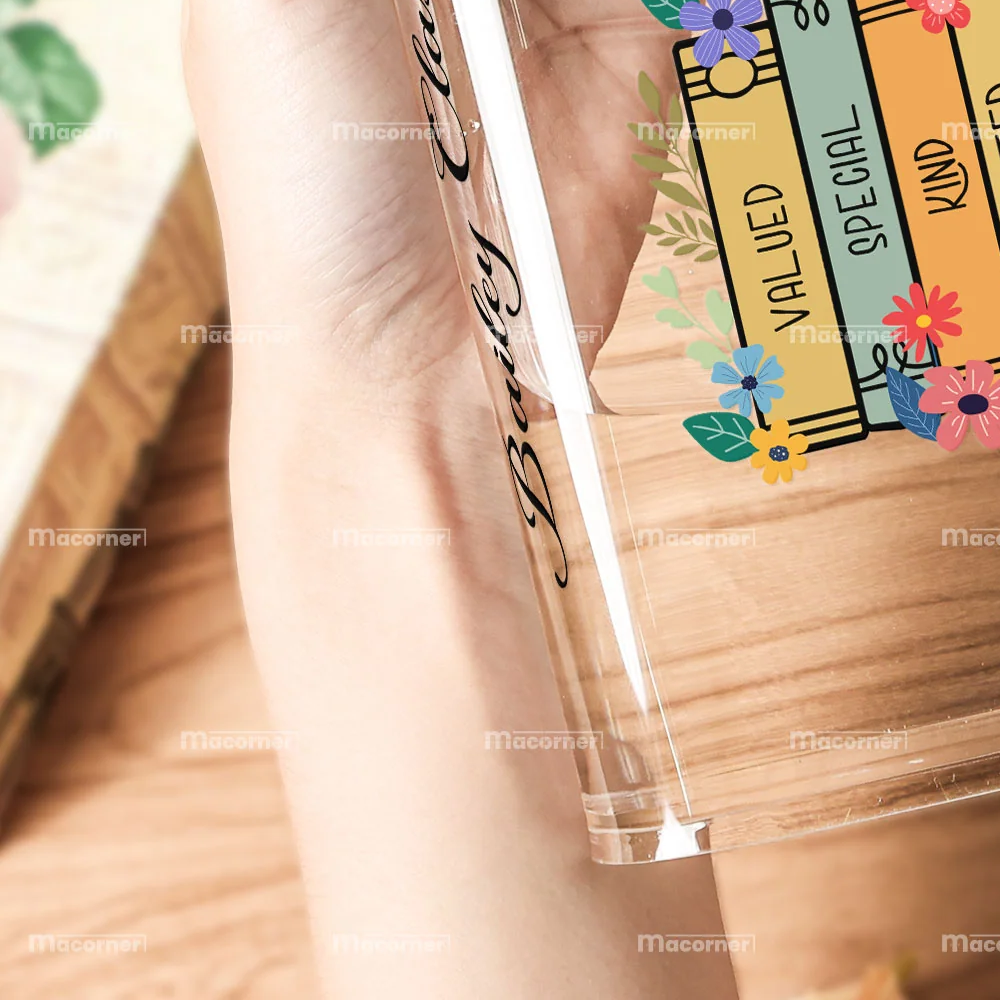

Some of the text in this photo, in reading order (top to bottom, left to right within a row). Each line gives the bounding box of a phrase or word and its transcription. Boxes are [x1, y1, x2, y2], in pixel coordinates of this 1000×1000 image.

[821, 103, 888, 256] SPECIAL
[913, 138, 969, 215] KIND
[743, 183, 810, 333] VALUED
[467, 219, 569, 589] Bailey
